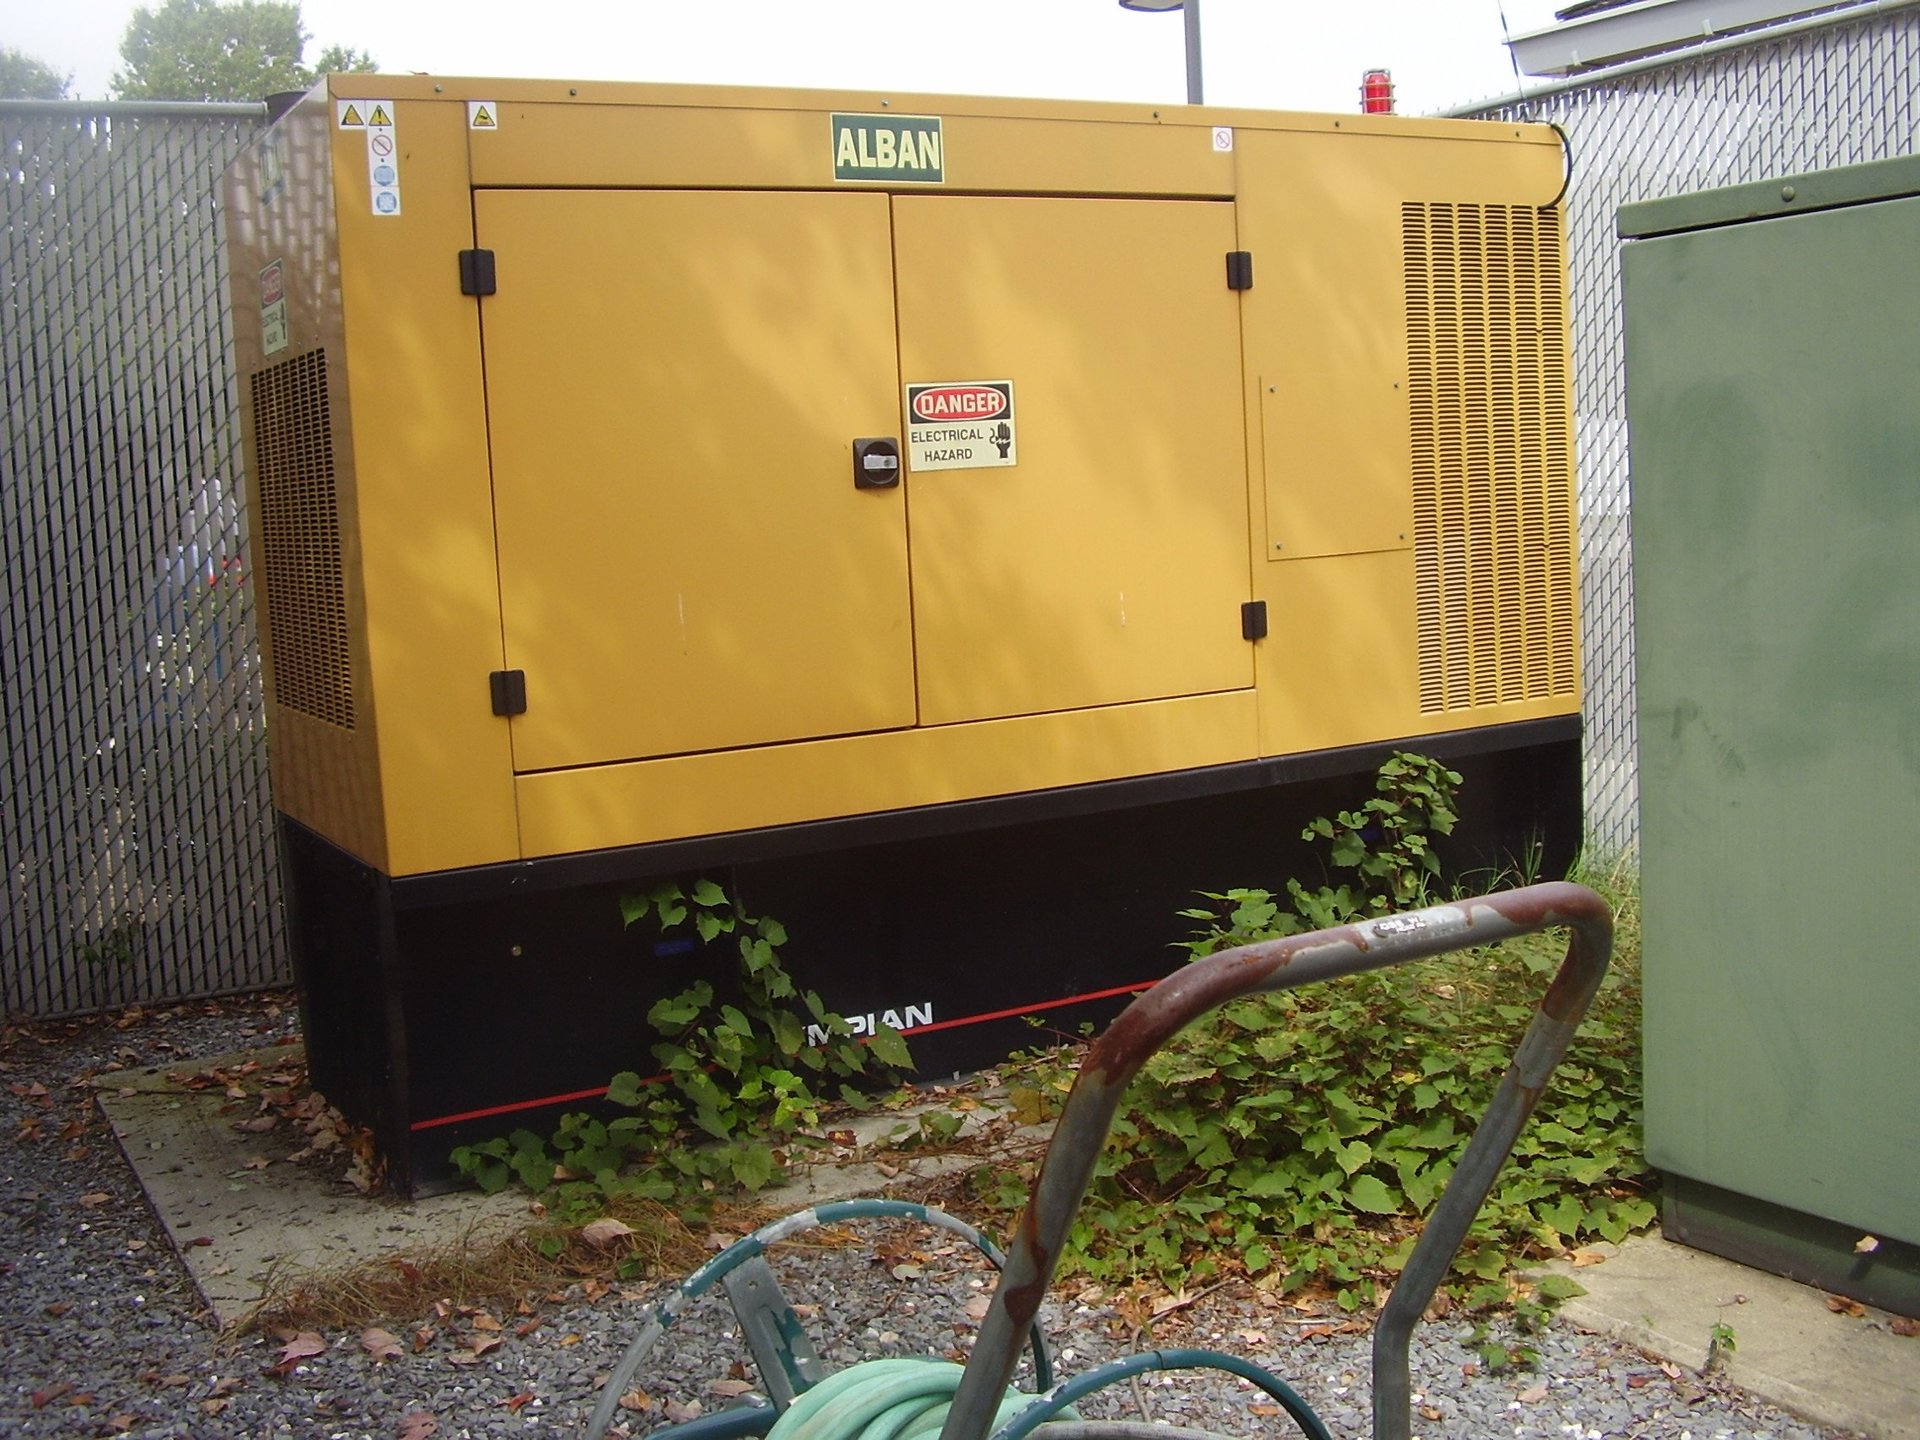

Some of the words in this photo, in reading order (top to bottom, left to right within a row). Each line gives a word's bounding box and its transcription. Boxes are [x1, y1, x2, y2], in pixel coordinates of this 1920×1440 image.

[837, 128, 940, 170] ALBAN
[921, 393, 1000, 414] DANGER
[911, 429, 984, 443] ELECTRICAL
[924, 449, 973, 462] HAZARD
[802, 1002, 933, 1047] MPIAN
